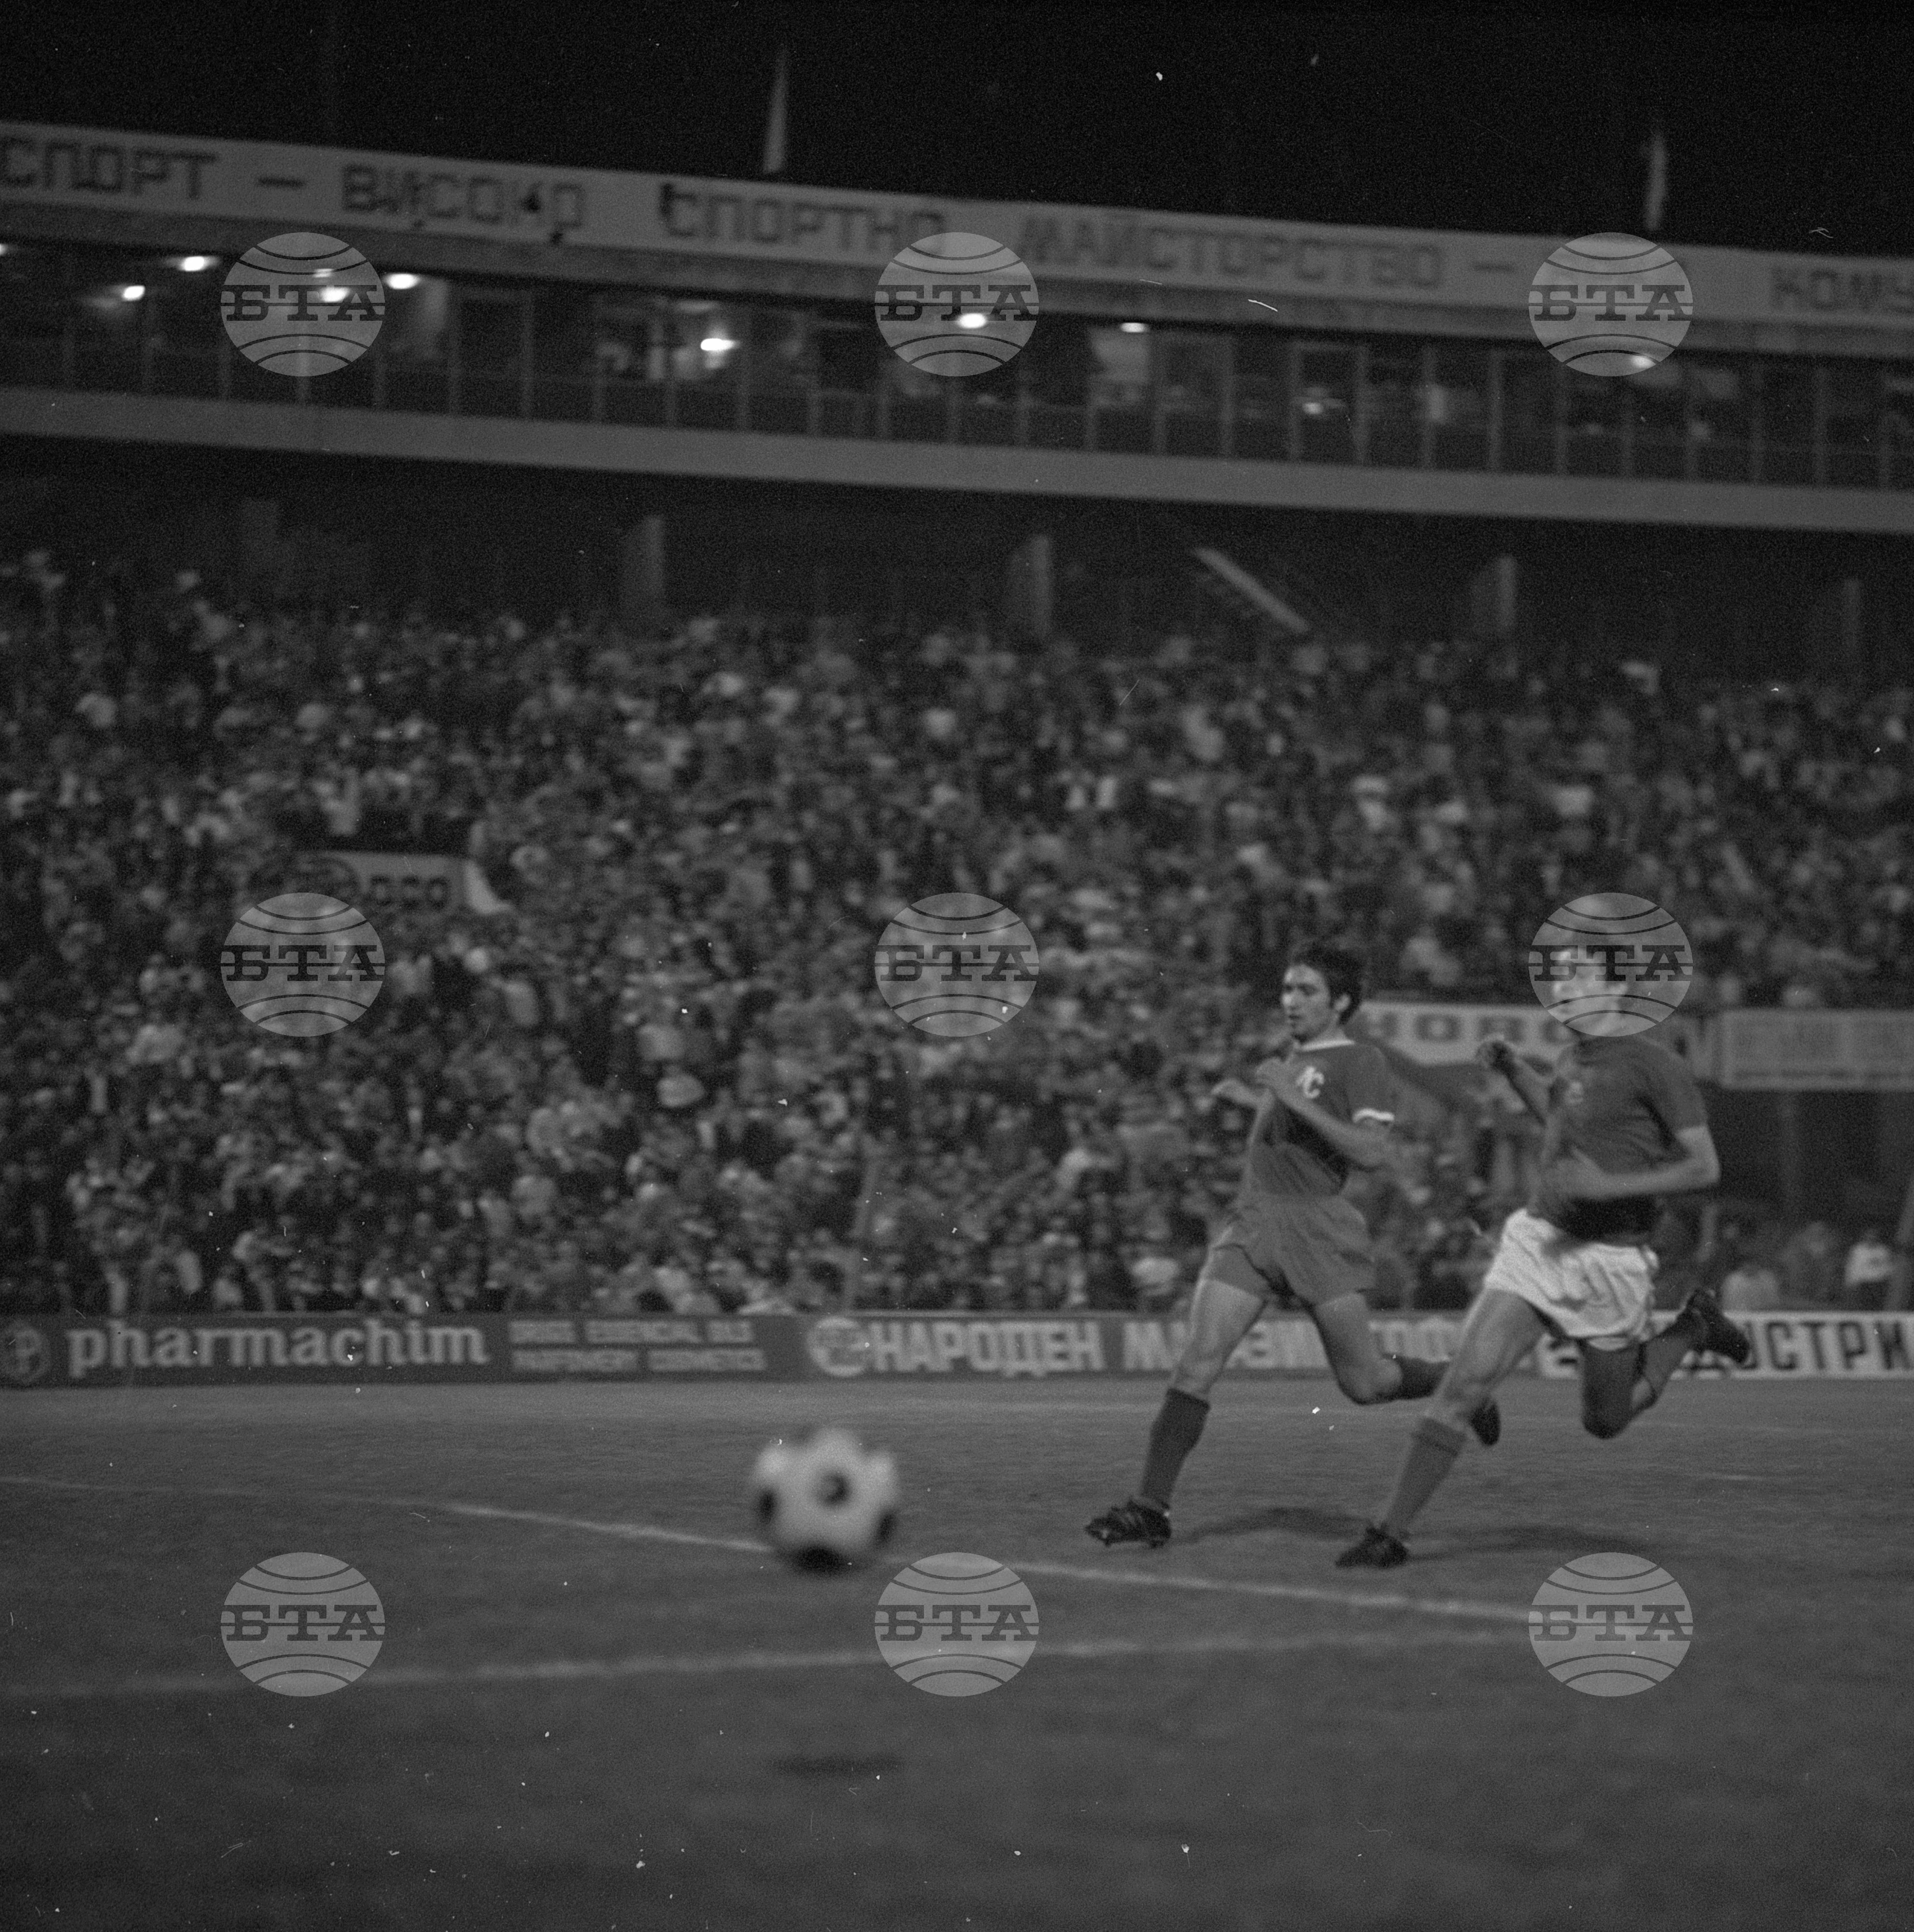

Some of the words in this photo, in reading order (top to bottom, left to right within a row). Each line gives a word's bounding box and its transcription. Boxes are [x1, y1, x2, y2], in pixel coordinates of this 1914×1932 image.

[0, 136, 219, 199] СПОРТ
[1018, 214, 1442, 289] МАЙСТОРСТВО
[66, 1318, 489, 1378] pharmachim
[869, 1321, 1106, 1377] НАРОДЕН
